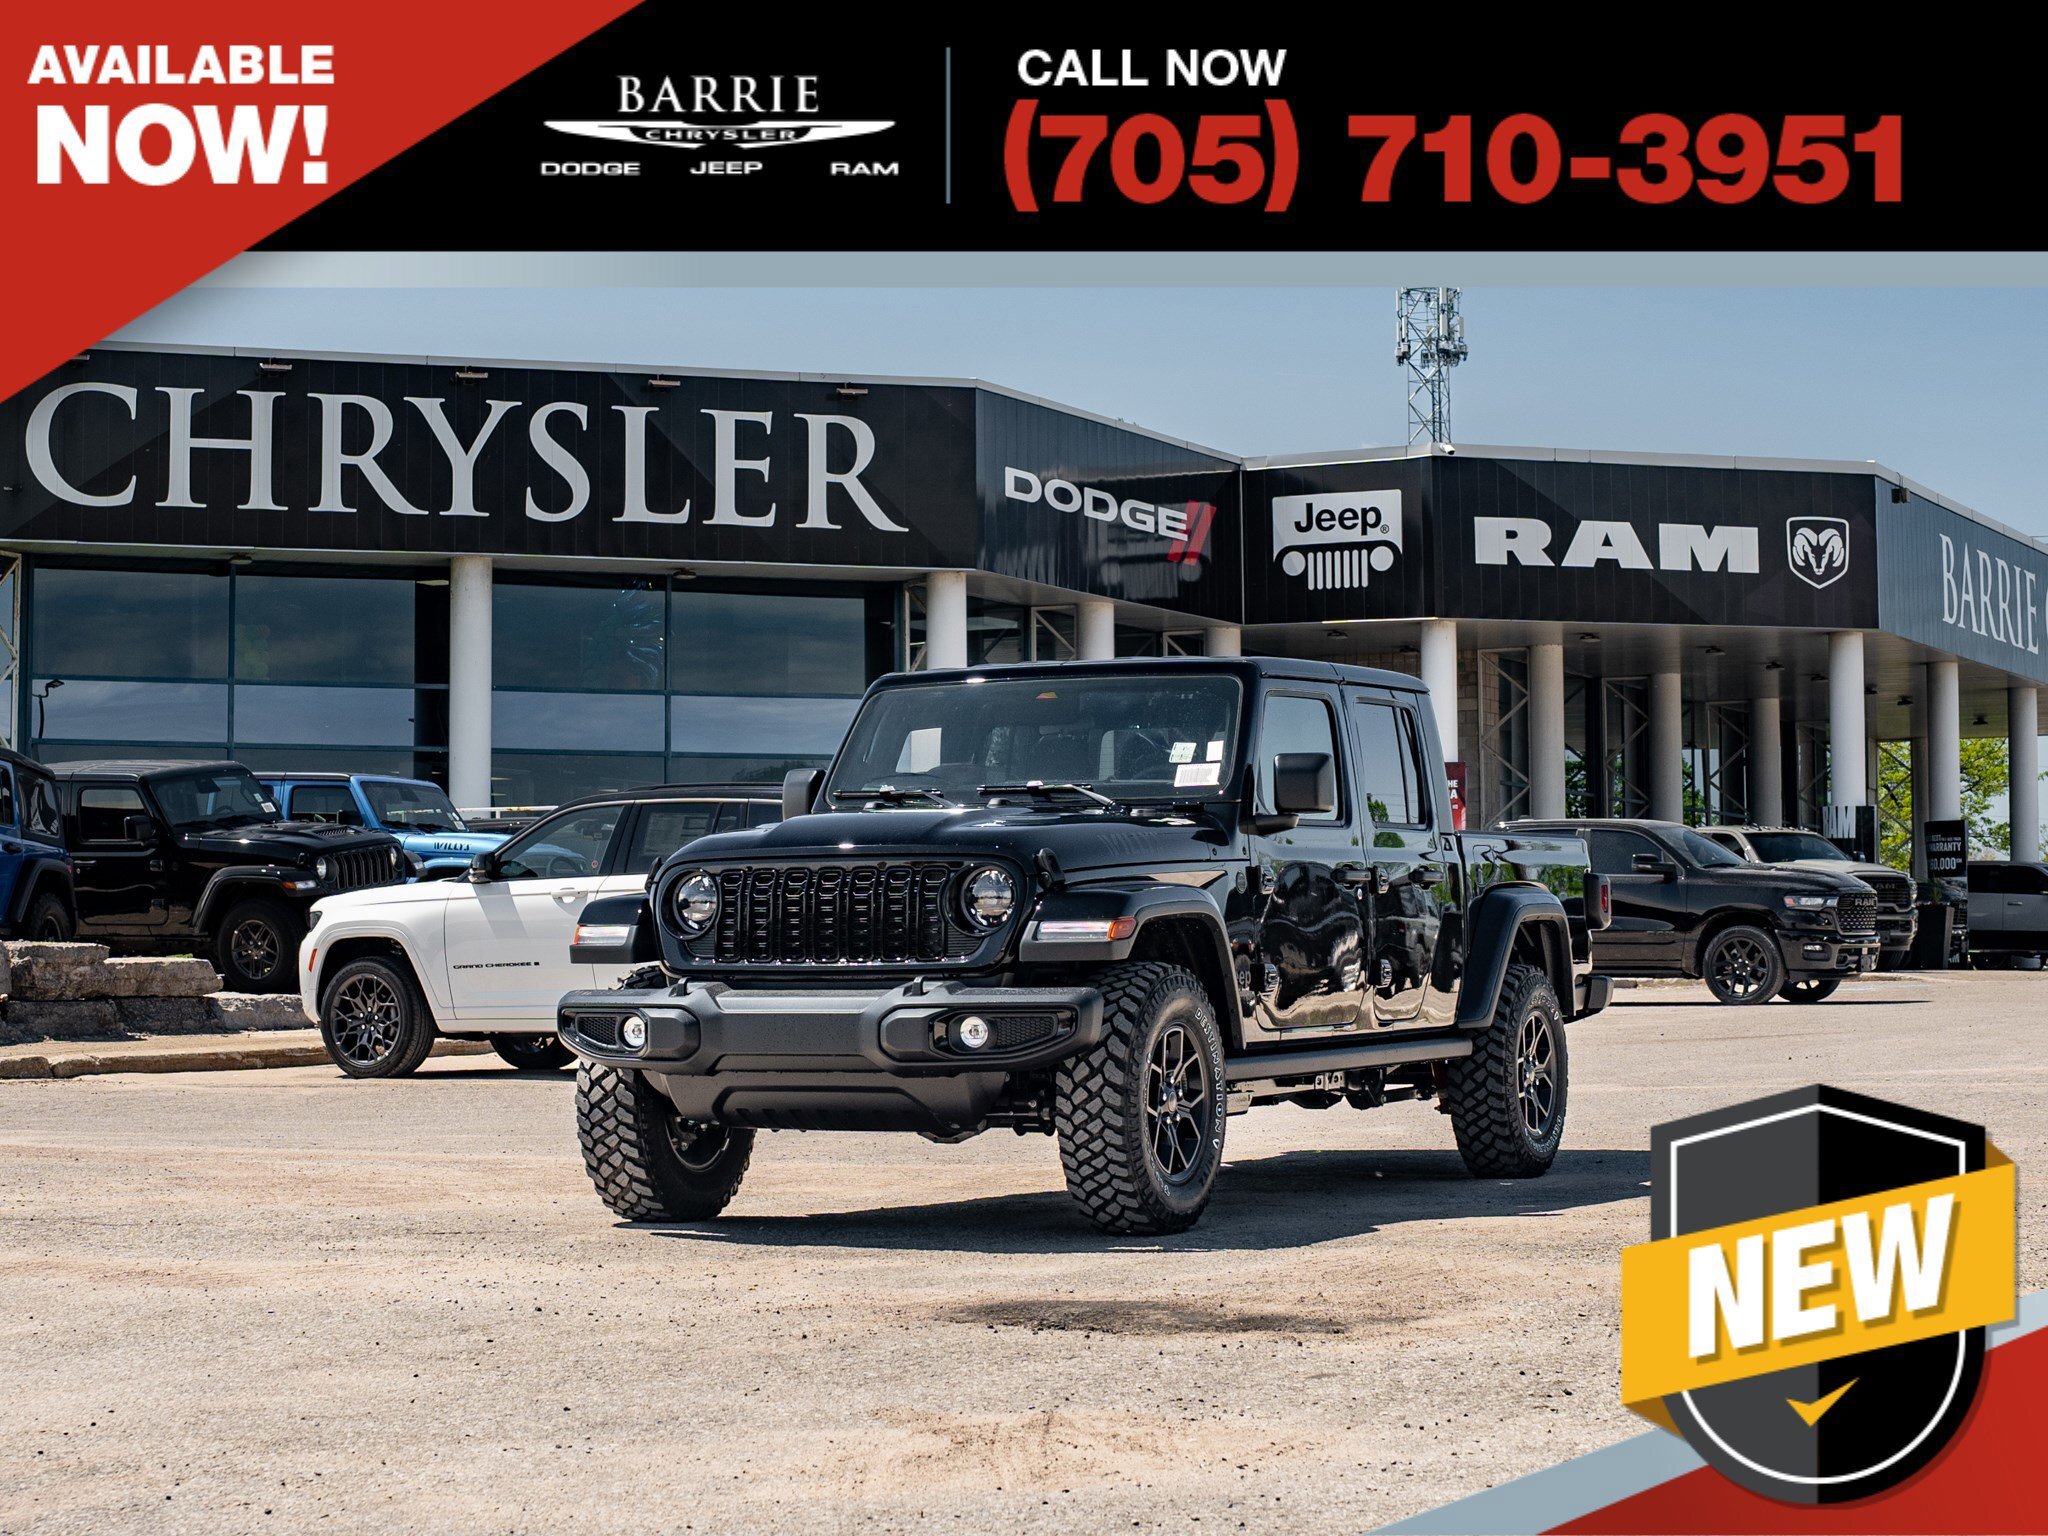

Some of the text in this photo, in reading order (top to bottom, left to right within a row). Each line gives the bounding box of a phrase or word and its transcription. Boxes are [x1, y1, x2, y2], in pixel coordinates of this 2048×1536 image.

[25, 381, 909, 533] CHRYSLER
[1004, 466, 1189, 541] DODGE
[1474, 516, 1761, 574] RAM
[1939, 533, 2039, 655] BARRIE
[433, 842, 471, 851] WILLYS
[1822, 806, 1857, 839] RAM
[1194, 1007, 1224, 1134] DESTINATION
